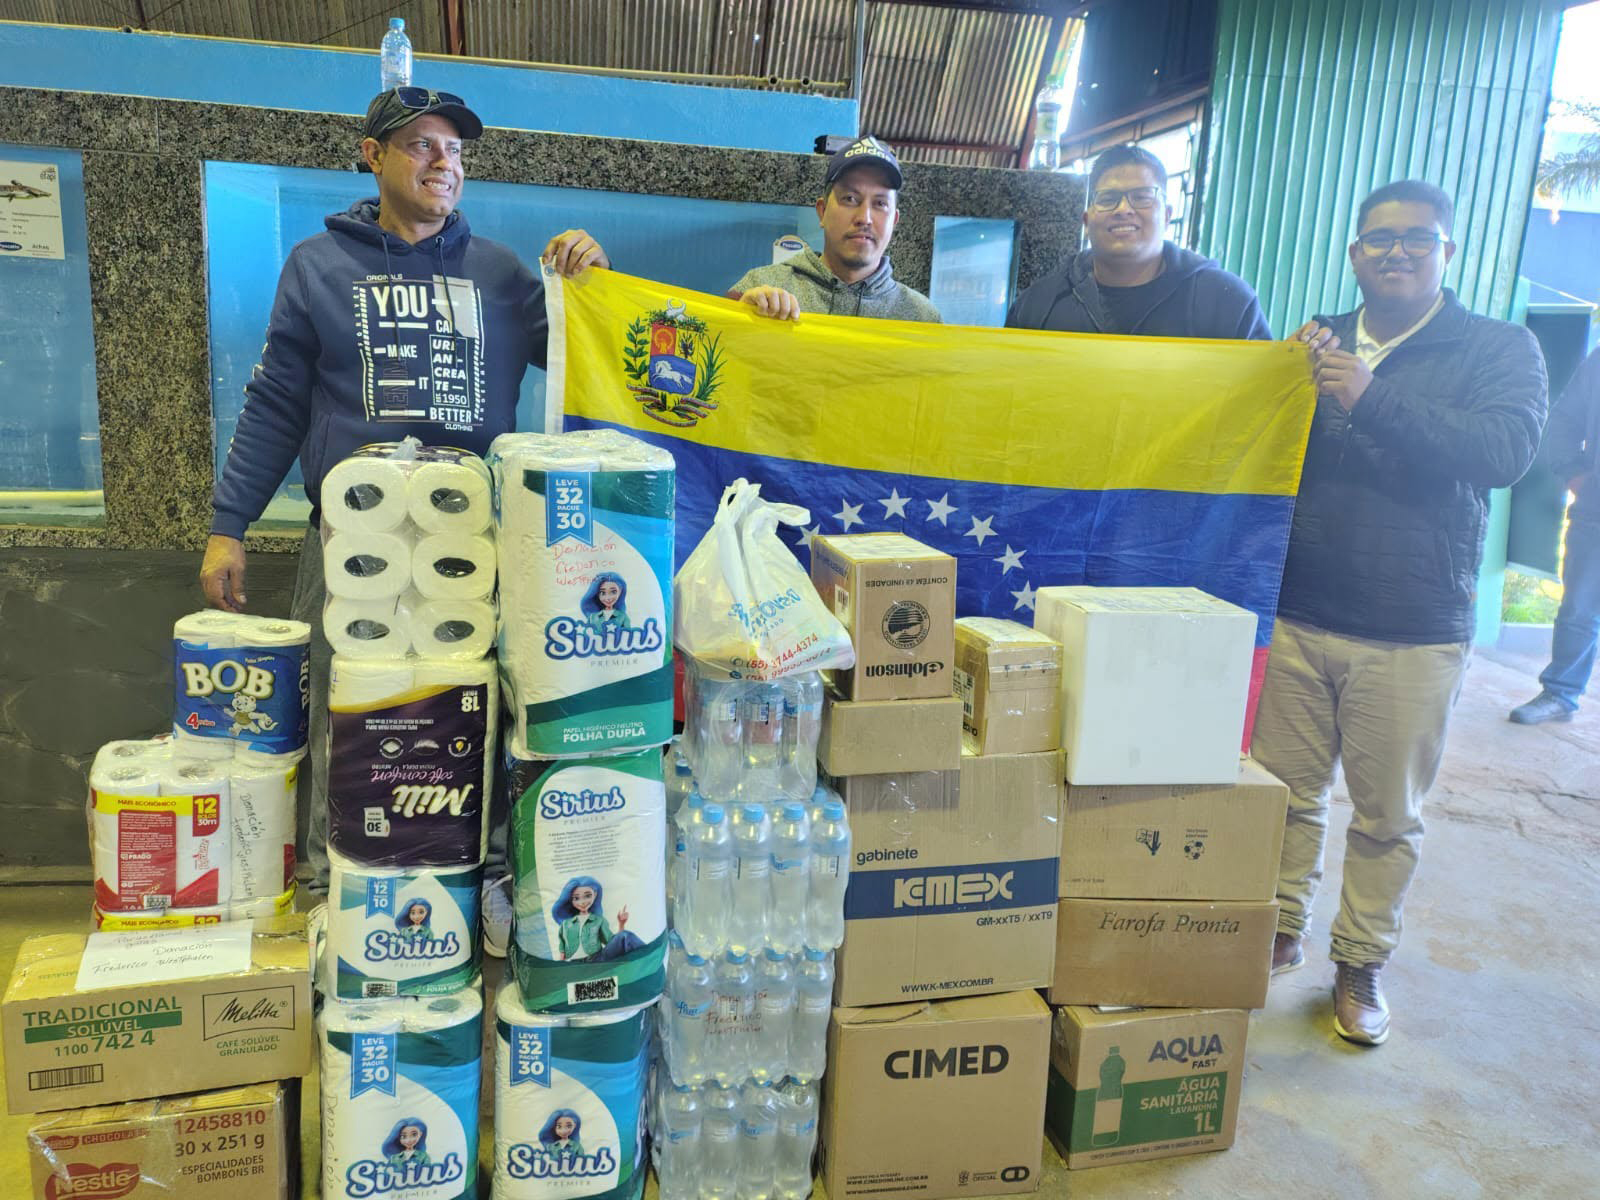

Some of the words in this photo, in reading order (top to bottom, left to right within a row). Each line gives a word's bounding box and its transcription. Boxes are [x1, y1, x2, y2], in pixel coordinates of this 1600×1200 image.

[371, 285, 429, 318] YOU
[387, 344, 418, 358] MAKE
[434, 367, 467, 380] CREA
[419, 377, 429, 390] IT
[443, 394, 467, 405] 1950
[430, 407, 472, 423] BETTER
[445, 423, 473, 432] CLOTHING
[555, 479, 579, 487] LEVE
[556, 487, 584, 505] 32
[556, 512, 586, 529] 30
[865, 579, 904, 588] UNIDADES
[545, 618, 662, 659] Sirius
[866, 661, 944, 678] Johnson
[181, 660, 275, 699] BOB
[461, 696, 481, 713] 18
[186, 712, 199, 729] 4
[563, 731, 604, 743] FOLHA
[607, 727, 646, 740] DUPLA
[194, 797, 217, 814] 12
[391, 783, 475, 818] Mili
[541, 786, 626, 820] Sirius
[366, 822, 382, 833] 30
[857, 848, 918, 865] gabinete
[374, 884, 388, 894] 12
[374, 898, 388, 908] 10
[1100, 911, 1166, 937] Farofa
[1173, 914, 1240, 934] Pronta
[365, 930, 460, 961] Sirius
[901, 977, 994, 993] WWW.K-MEX.COM.BR
[22, 996, 183, 1027] TRADICIONAL
[213, 997, 280, 1026] Melitta
[67, 1017, 142, 1038] SOLÚVEL
[518, 1032, 539, 1040] LEVE
[55, 1043, 89, 1057] 1100
[219, 1043, 277, 1057] GRANULADO
[361, 1038, 384, 1046] LEVE
[518, 1040, 543, 1055] 32
[1148, 1034, 1224, 1063] AQUA
[362, 1045, 388, 1061] 32
[518, 1061, 544, 1076] 30
[884, 1045, 1009, 1079] CIMED
[1192, 1058, 1218, 1069] FAST
[361, 1066, 389, 1083] 30
[1178, 1076, 1220, 1092] ÁGUA
[1139, 1090, 1219, 1110] SANITÁRIA
[174, 1110, 266, 1135] 12458810
[1193, 1112, 1216, 1133] 1L
[175, 1141, 196, 1157] 30
[201, 1141, 212, 1153] x
[217, 1133, 247, 1151] 251
[254, 1134, 265, 1149] g
[182, 1154, 264, 1176] ESPECIALIDADES
[508, 1144, 616, 1179] Sirius
[197, 1167, 249, 1183] BOMBONS
[252, 1165, 265, 1175] BR
[346, 1152, 462, 1198] Sirius
